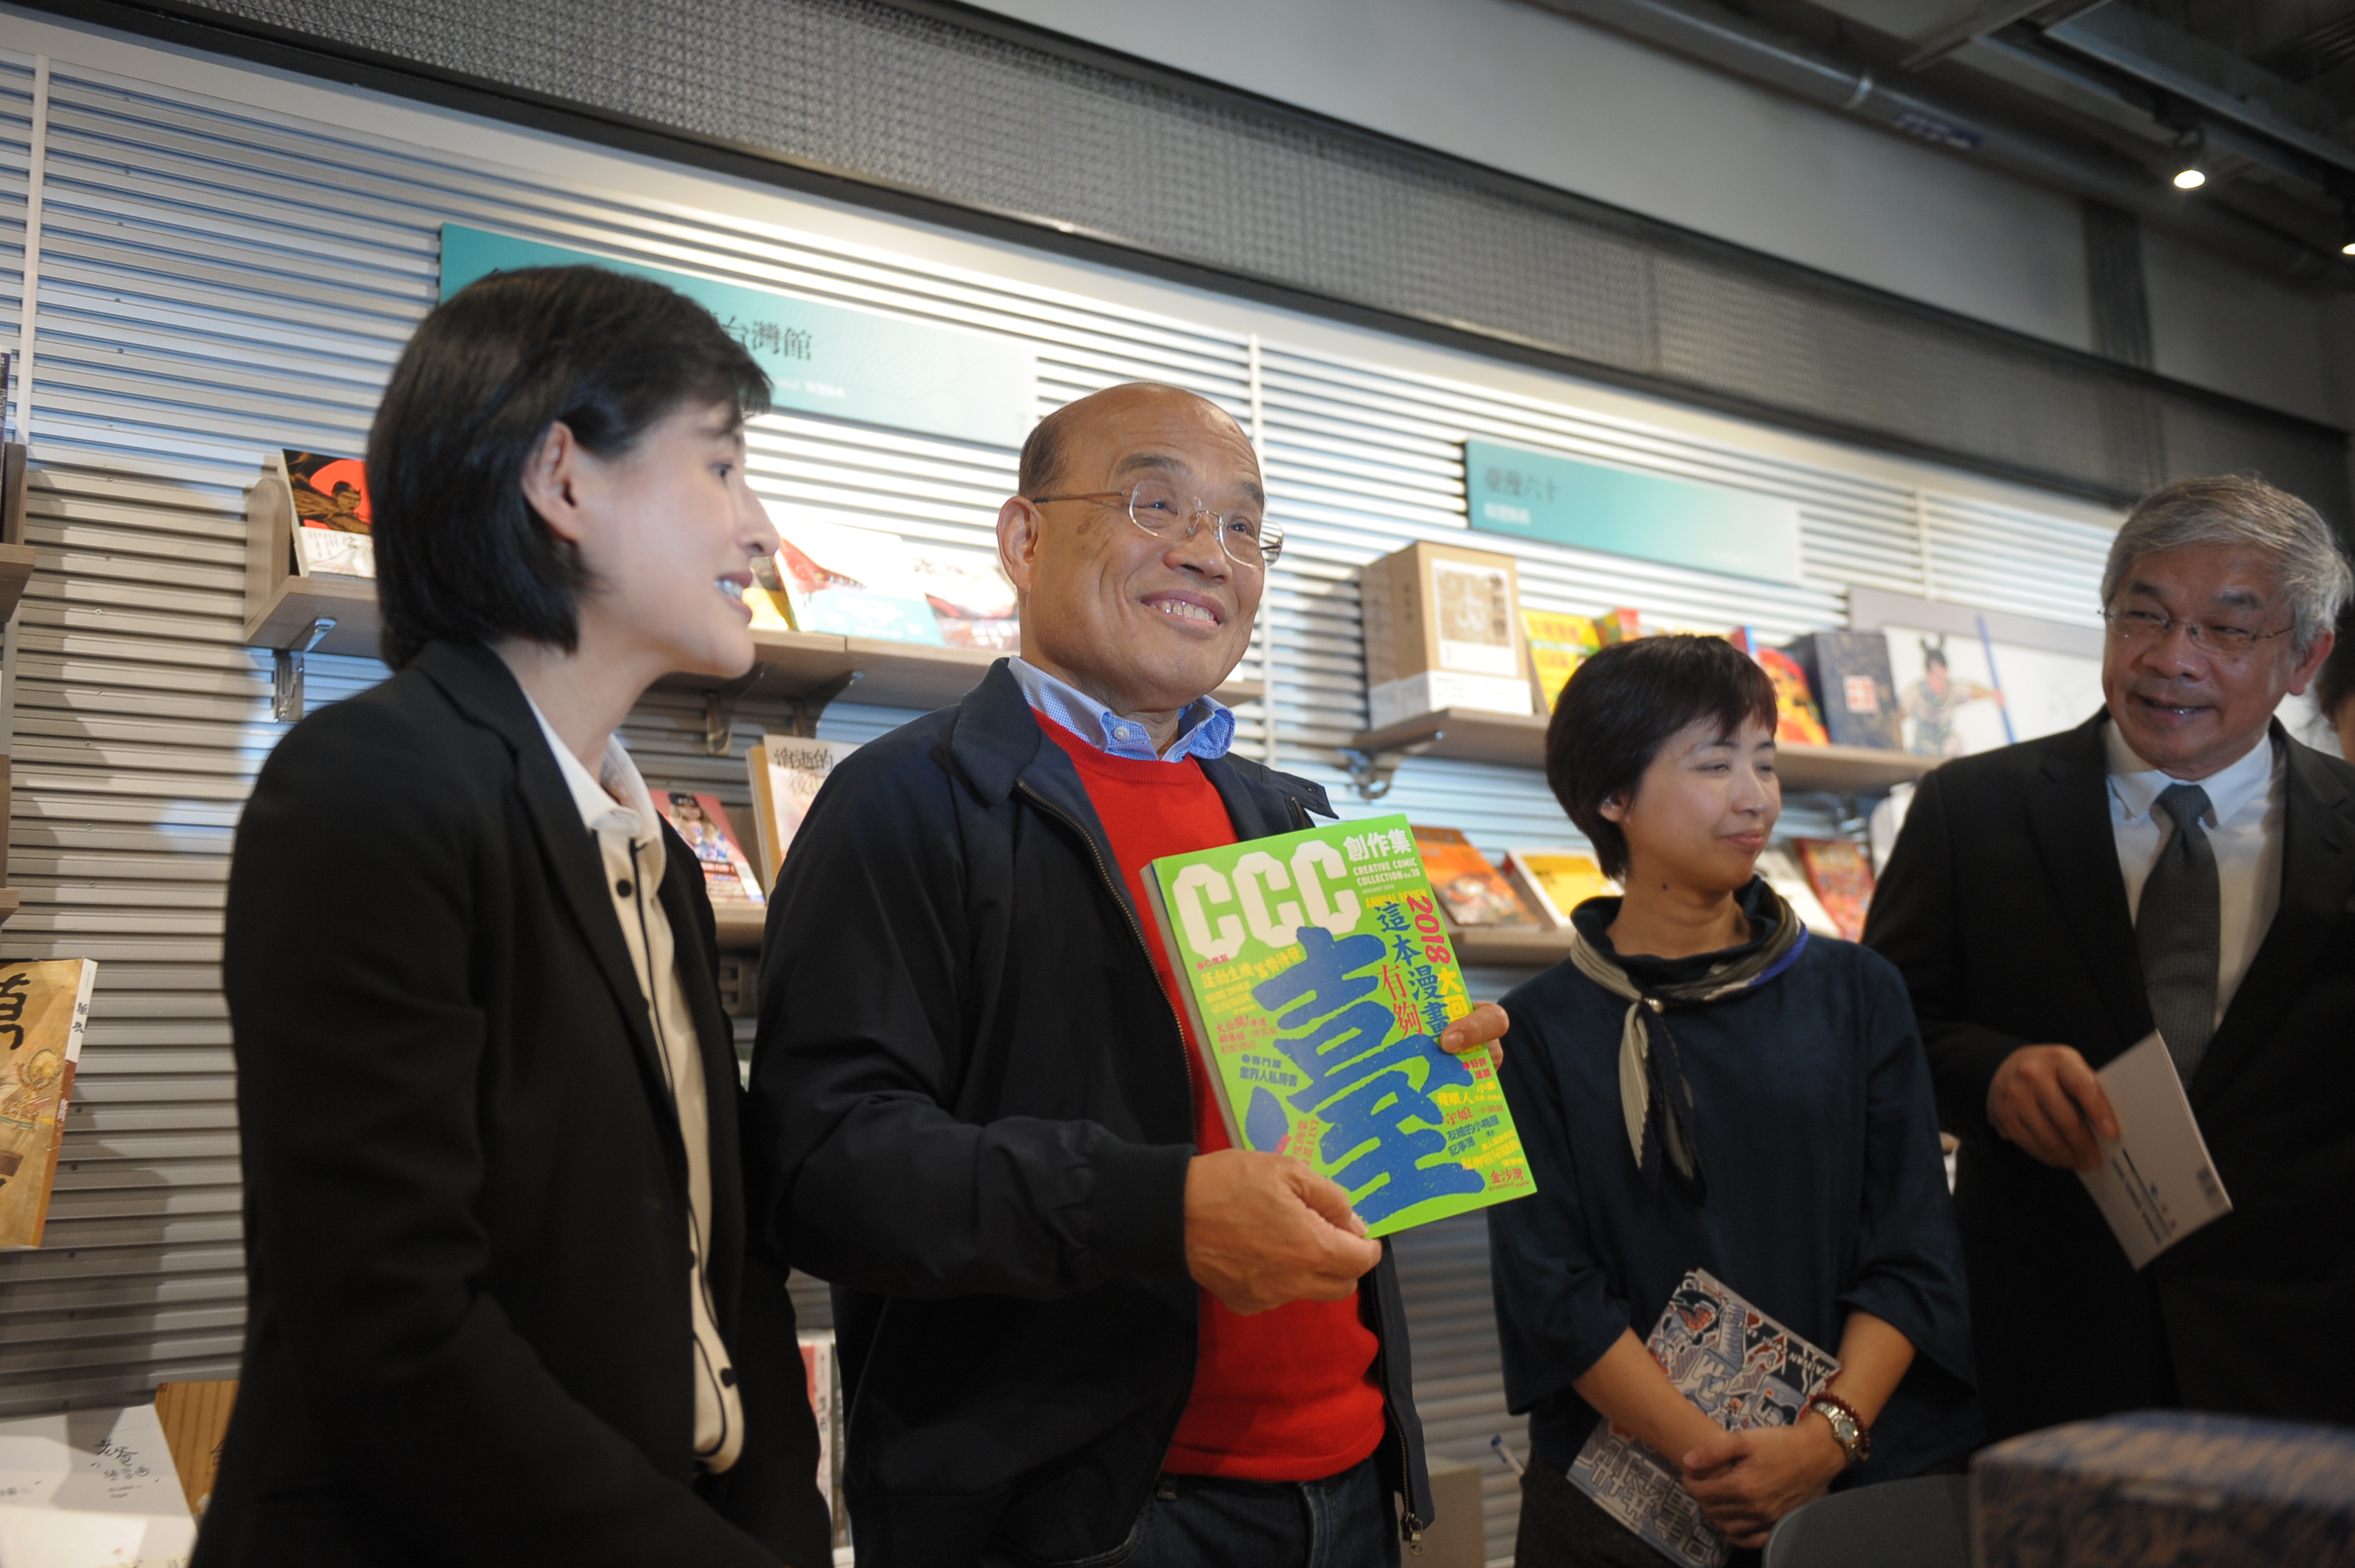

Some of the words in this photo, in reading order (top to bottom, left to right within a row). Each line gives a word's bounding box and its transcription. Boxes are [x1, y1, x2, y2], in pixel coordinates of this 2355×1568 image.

[1342, 828, 1412, 862] 創作集
[1353, 861, 1391, 876] CREATIVE
[1393, 857, 1418, 869] COMIC
[1172, 839, 1362, 959] CCC
[1356, 871, 1404, 886] COLLECTION
[1365, 893, 1399, 909] ANNUAL
[1406, 895, 1451, 964] 2018
[1374, 901, 1450, 1039] 這本漫畫
[1376, 964, 1423, 1038] 有夠
